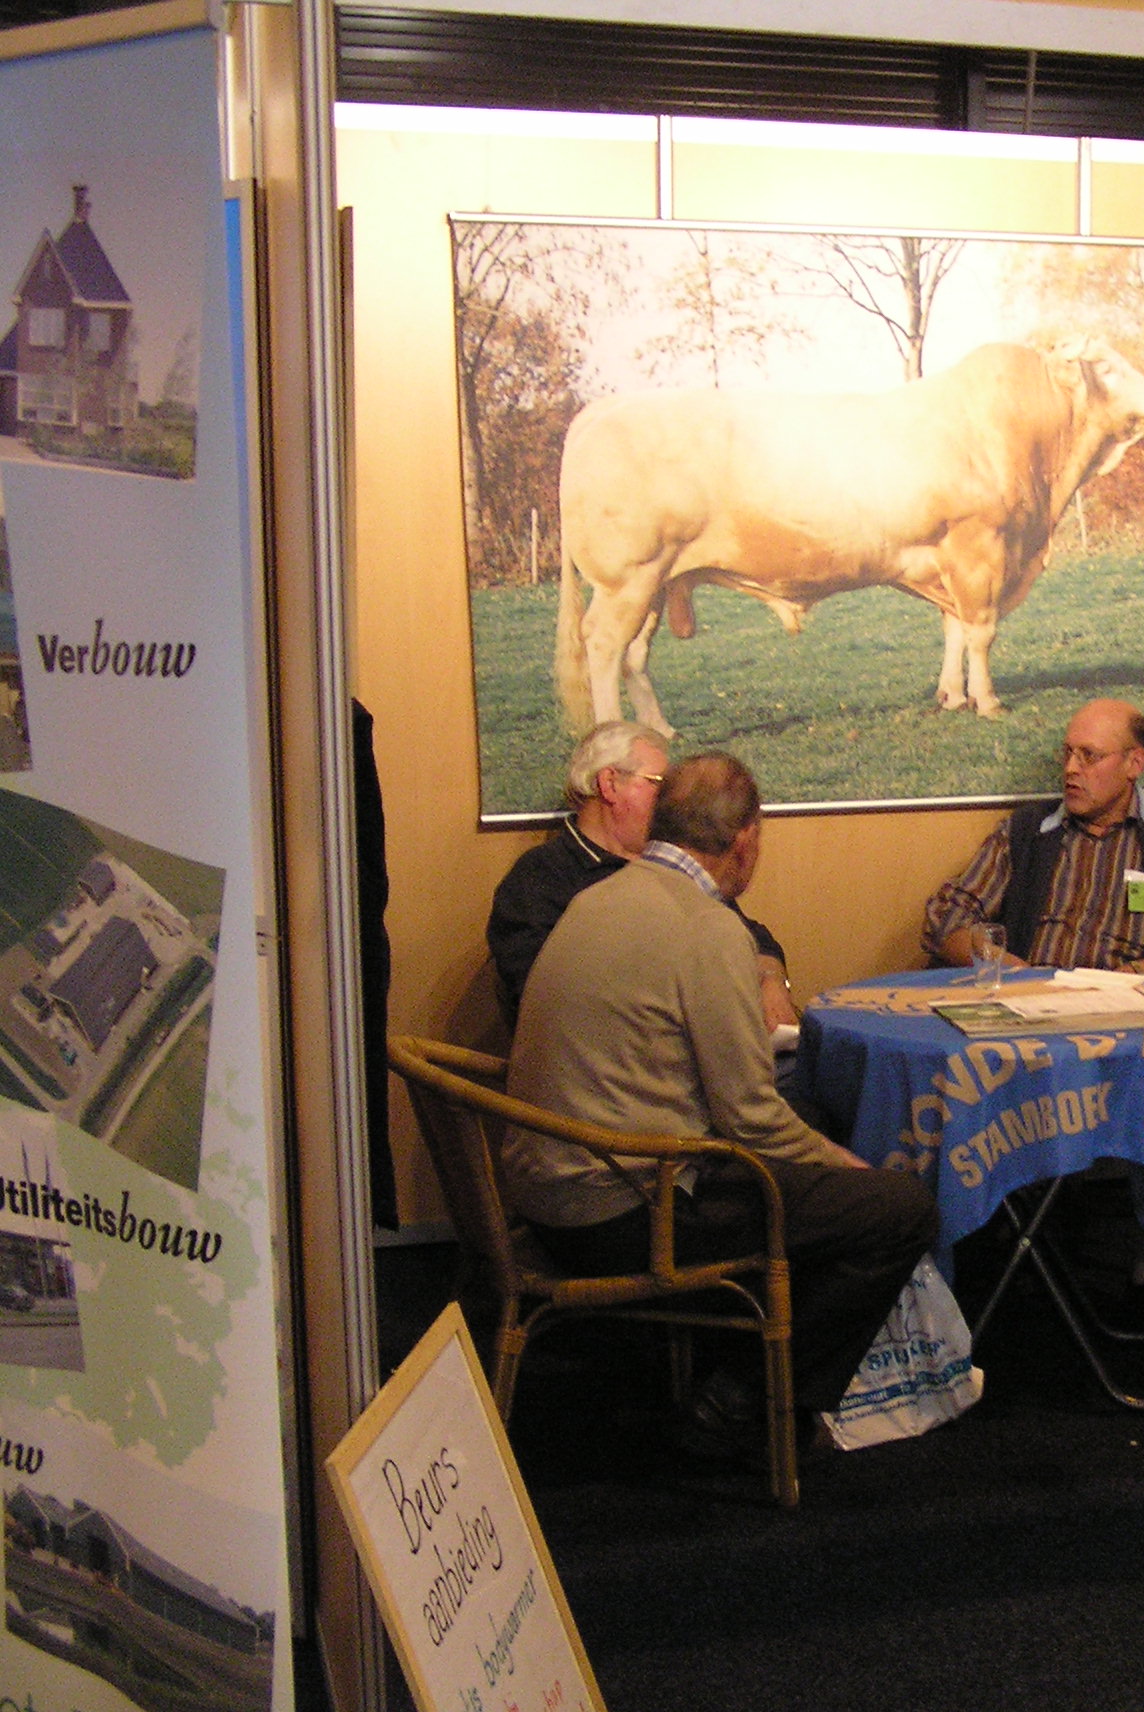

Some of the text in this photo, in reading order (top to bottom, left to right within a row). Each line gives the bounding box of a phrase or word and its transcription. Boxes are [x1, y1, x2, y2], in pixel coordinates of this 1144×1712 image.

[36, 617, 197, 678] Verbouw
[0, 1176, 222, 1263] tiliteitsbouw
[381, 1446, 460, 1555] Beurs
[422, 1504, 505, 1649] aanbieding
